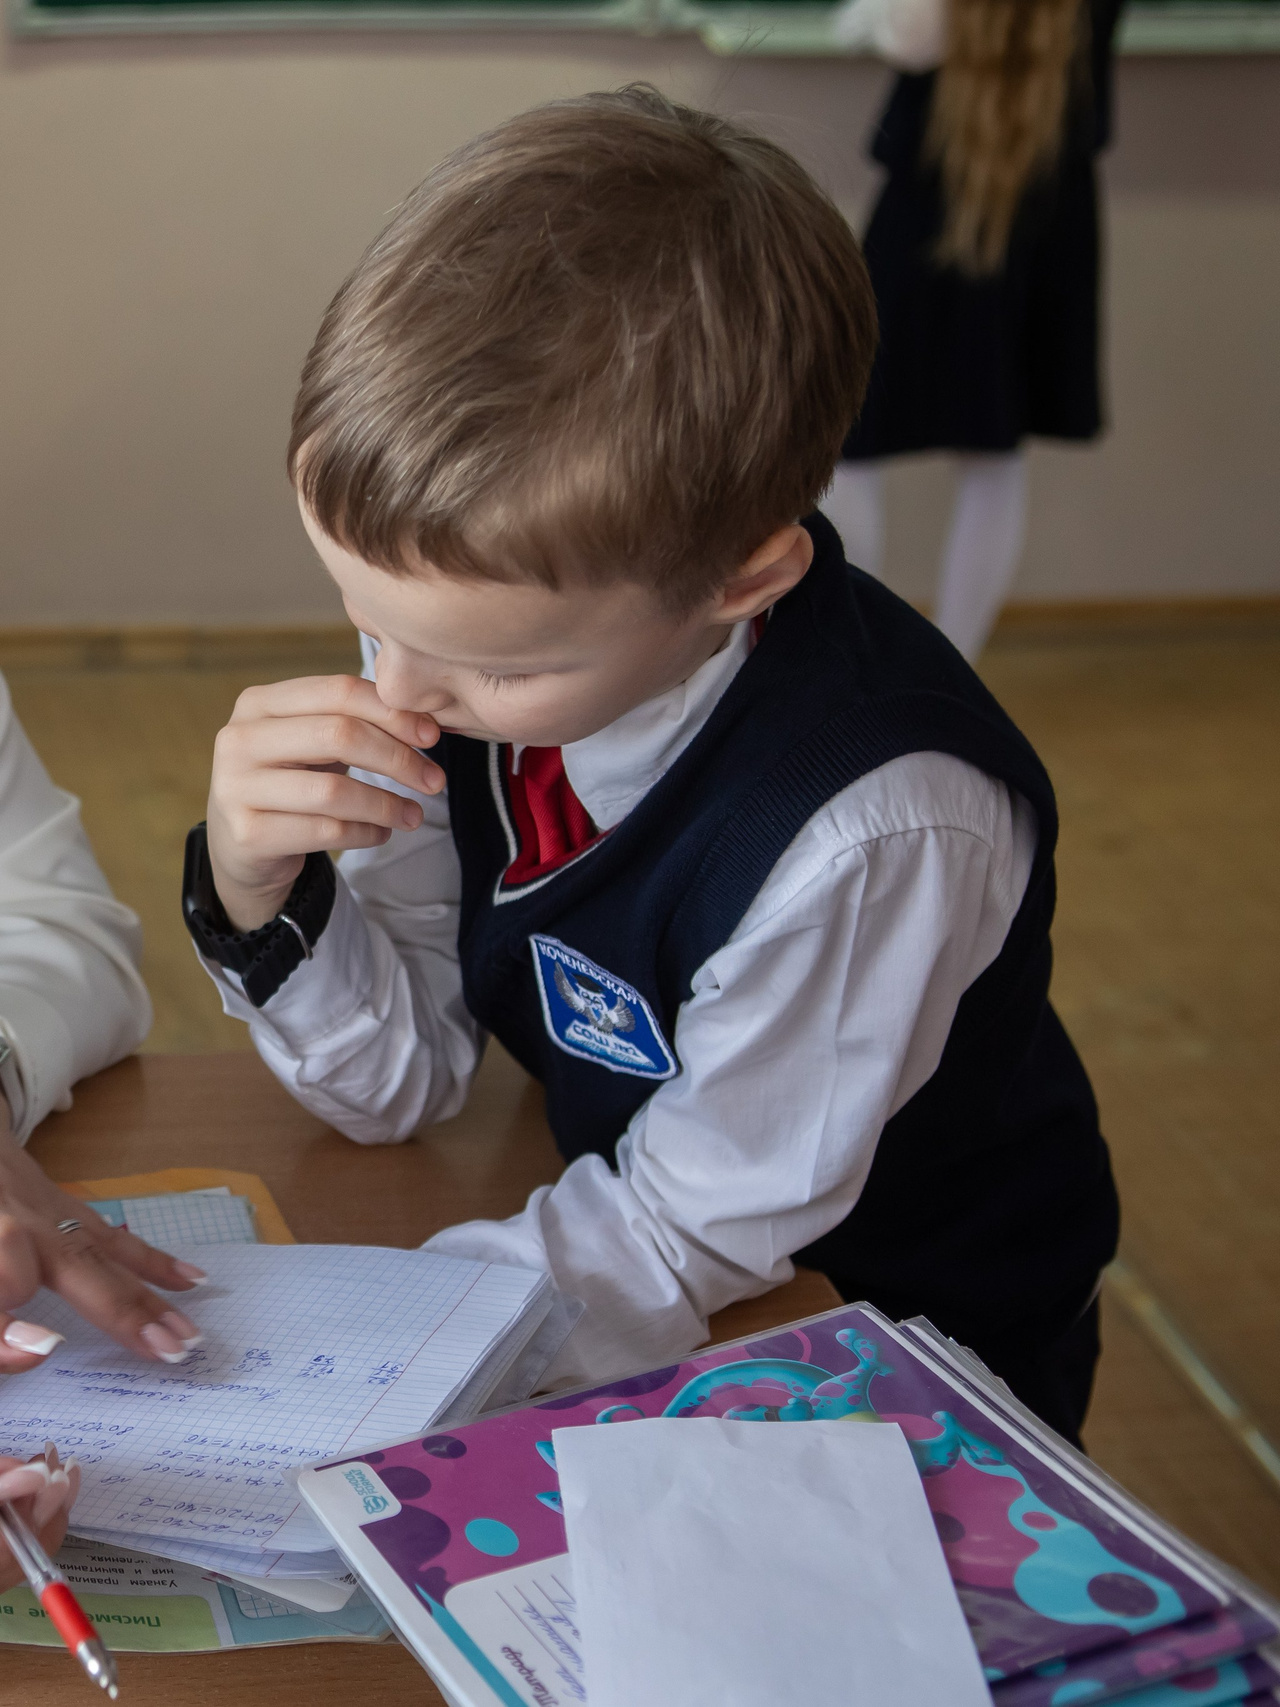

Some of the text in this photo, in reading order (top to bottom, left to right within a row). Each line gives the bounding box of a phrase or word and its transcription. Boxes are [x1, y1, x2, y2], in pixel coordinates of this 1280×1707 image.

[349, 1468, 378, 1496] FORMAT
[55, 1563, 125, 1574] вычитания.
[67, 1576, 178, 1588] Узнаем правила
